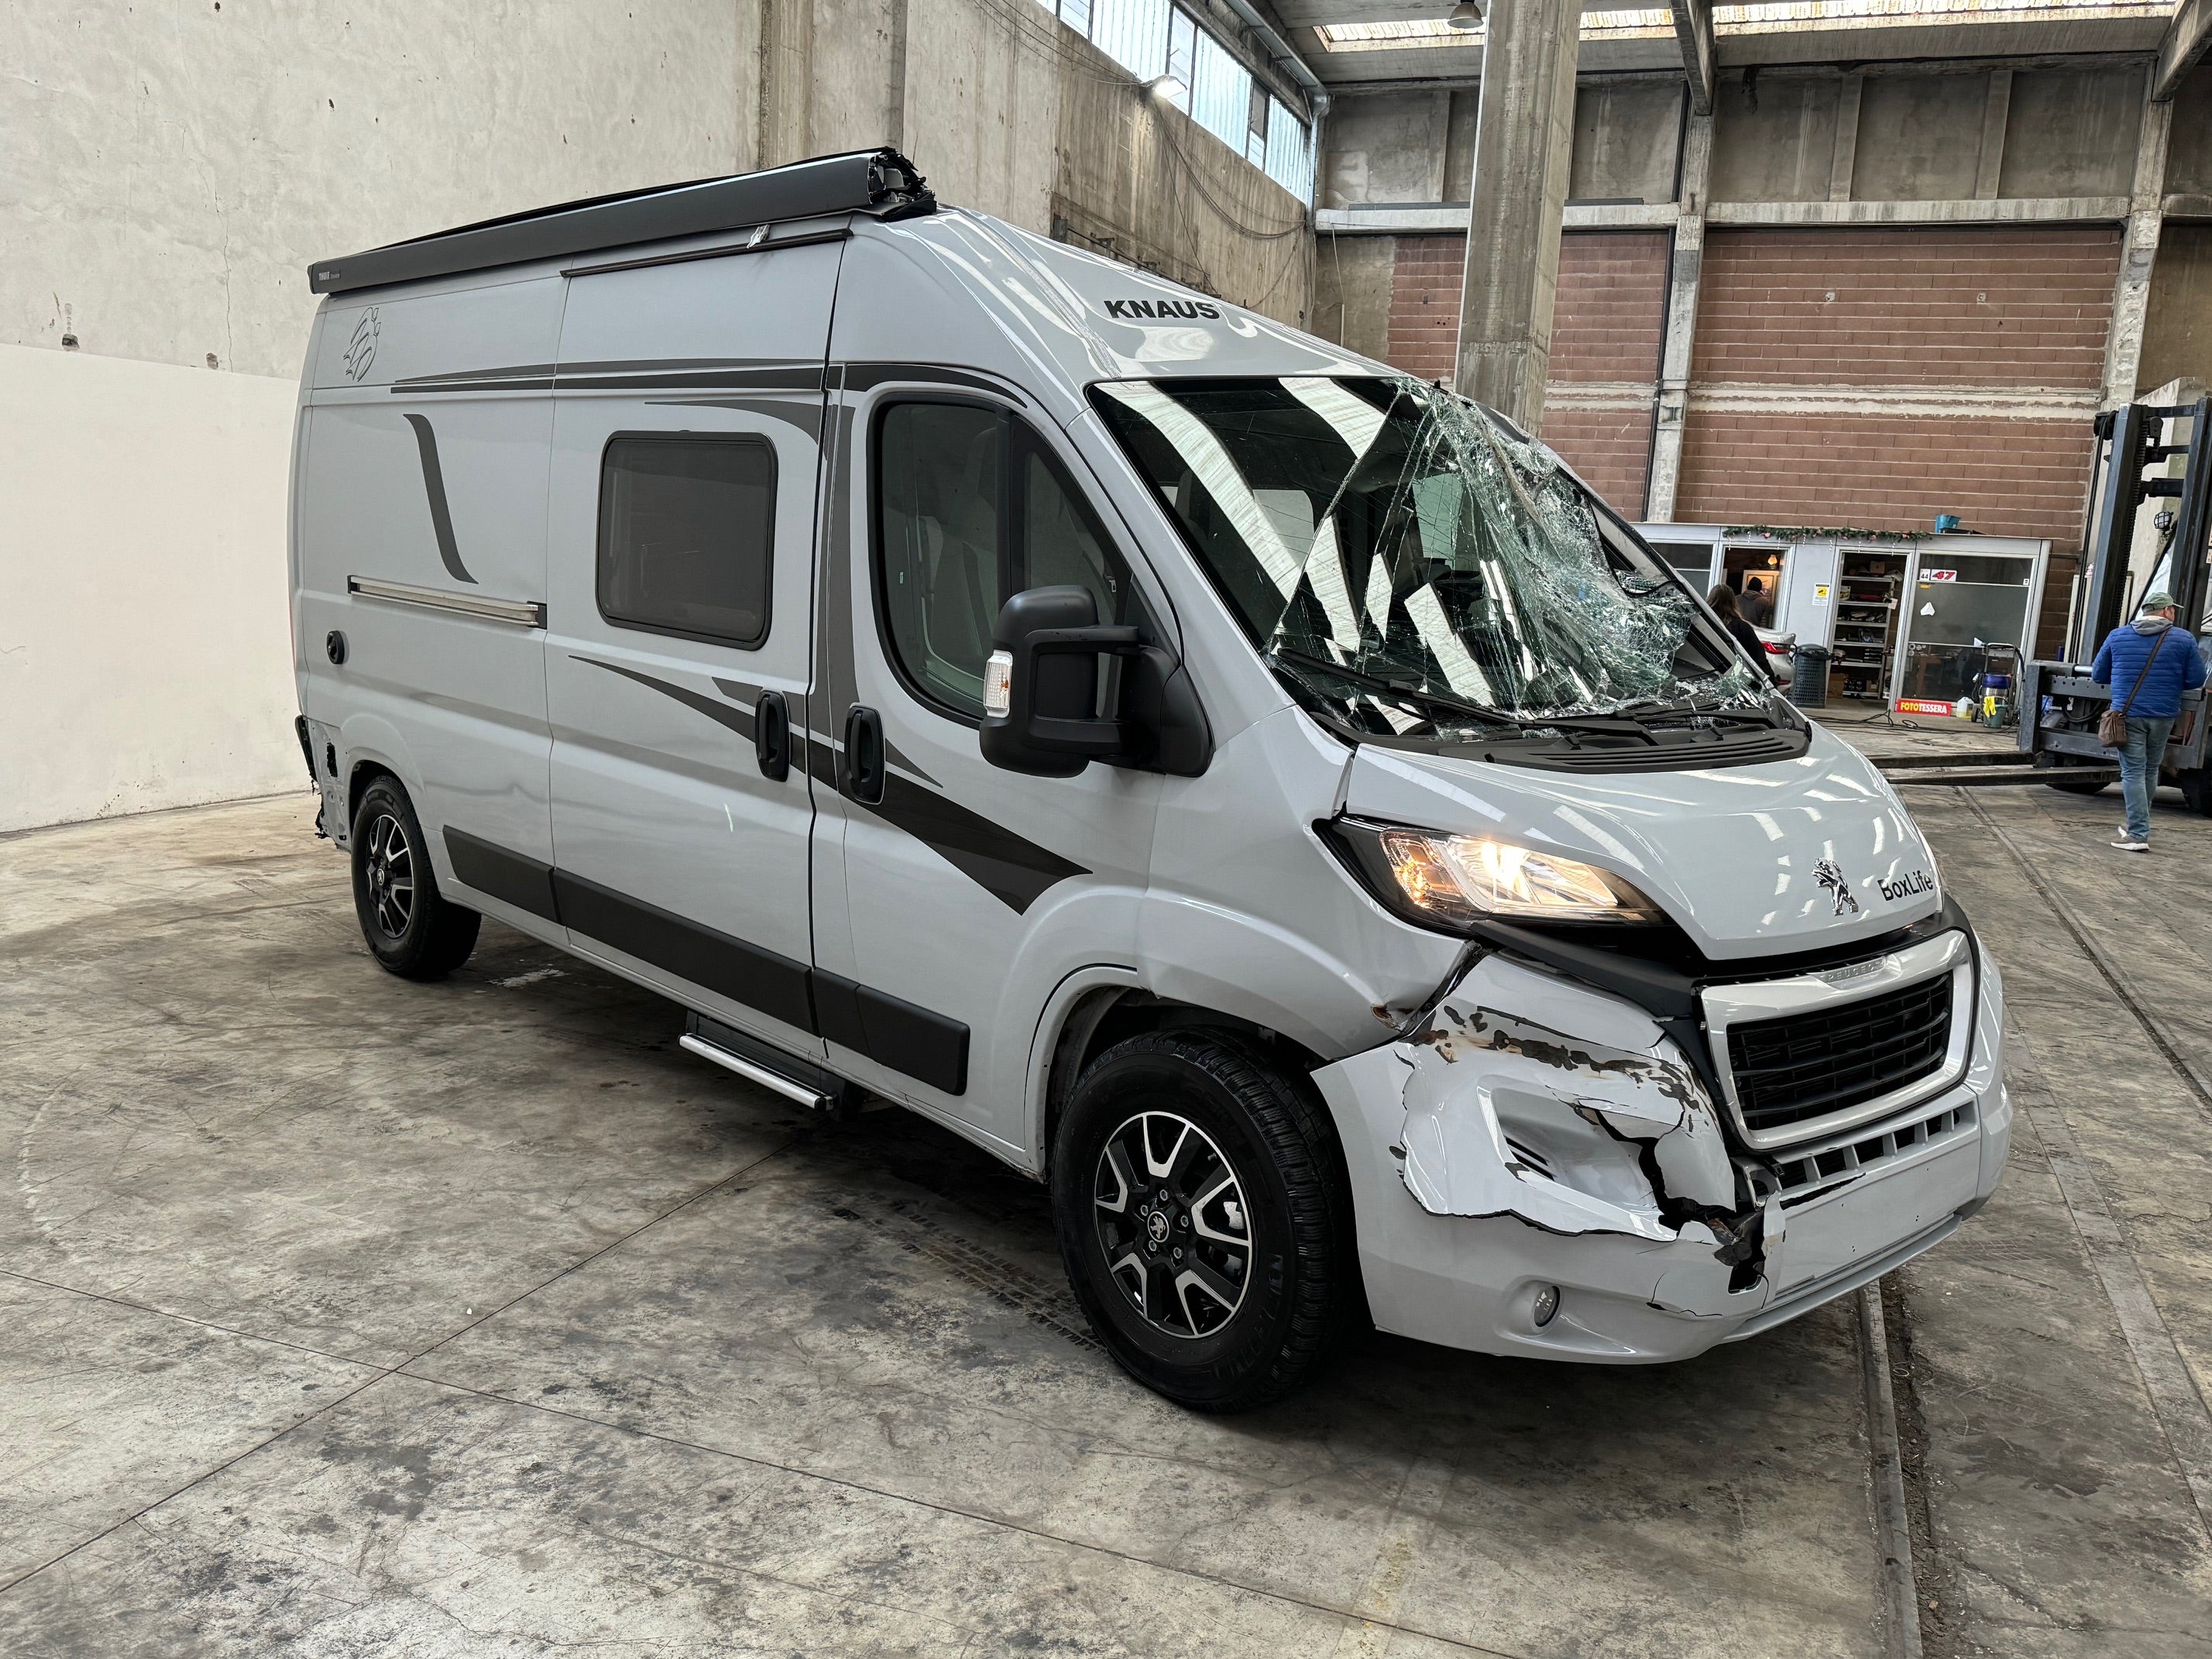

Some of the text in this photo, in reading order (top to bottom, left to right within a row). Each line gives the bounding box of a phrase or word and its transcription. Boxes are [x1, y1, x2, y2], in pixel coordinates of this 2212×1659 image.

[1104, 300, 1220, 320] KNAUS
[1932, 571, 1956, 580] 47
[1900, 702, 1947, 713] FOTOTESSERA
[1877, 870, 1933, 902] BoxLife
